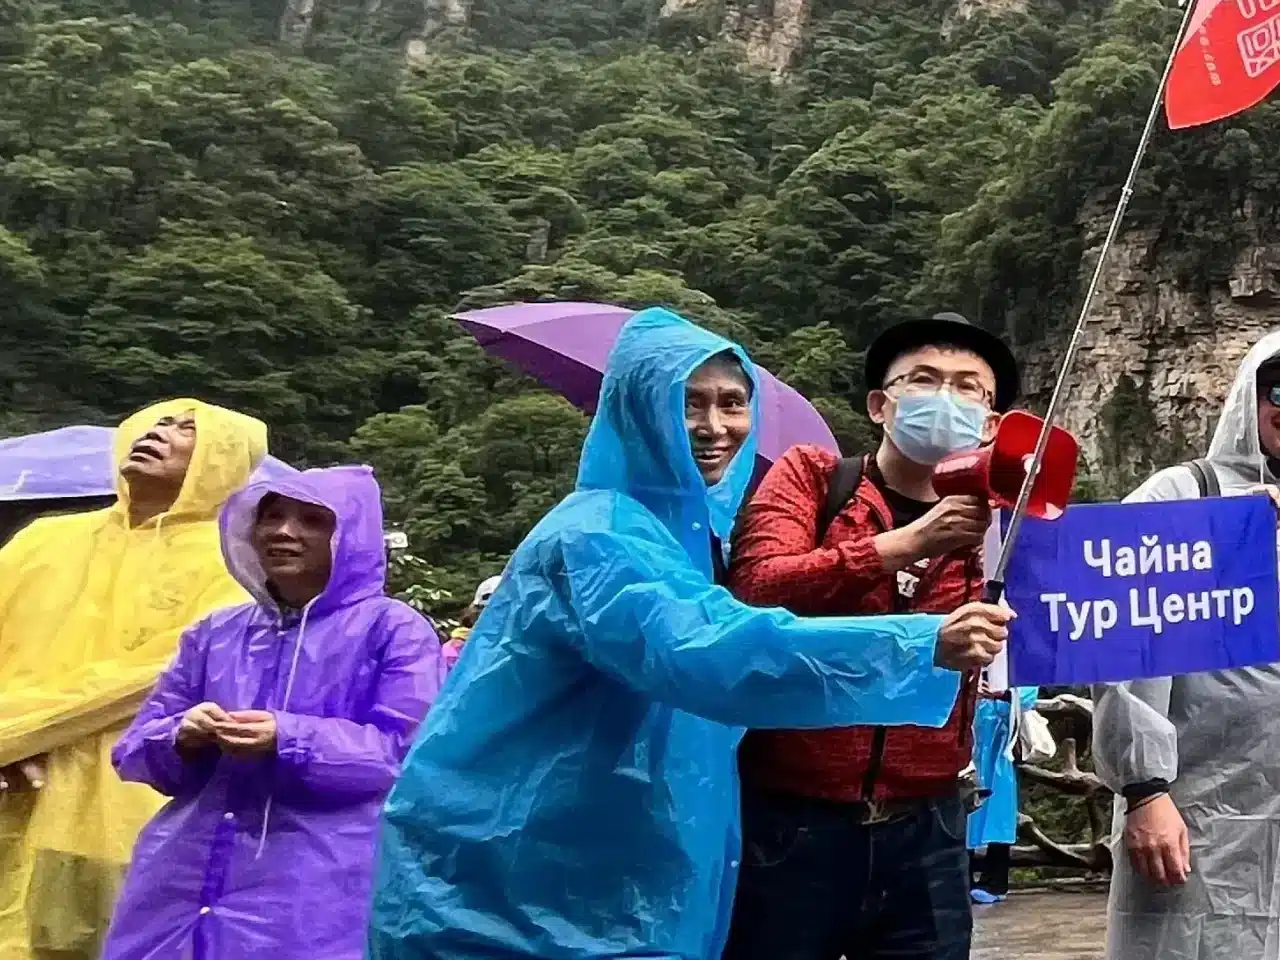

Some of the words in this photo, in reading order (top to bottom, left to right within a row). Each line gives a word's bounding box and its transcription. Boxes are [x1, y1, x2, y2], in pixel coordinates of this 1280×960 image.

[1083, 534, 1213, 577] Чайна
[1040, 592, 1118, 640] Тур
[1128, 586, 1255, 634] Центр
